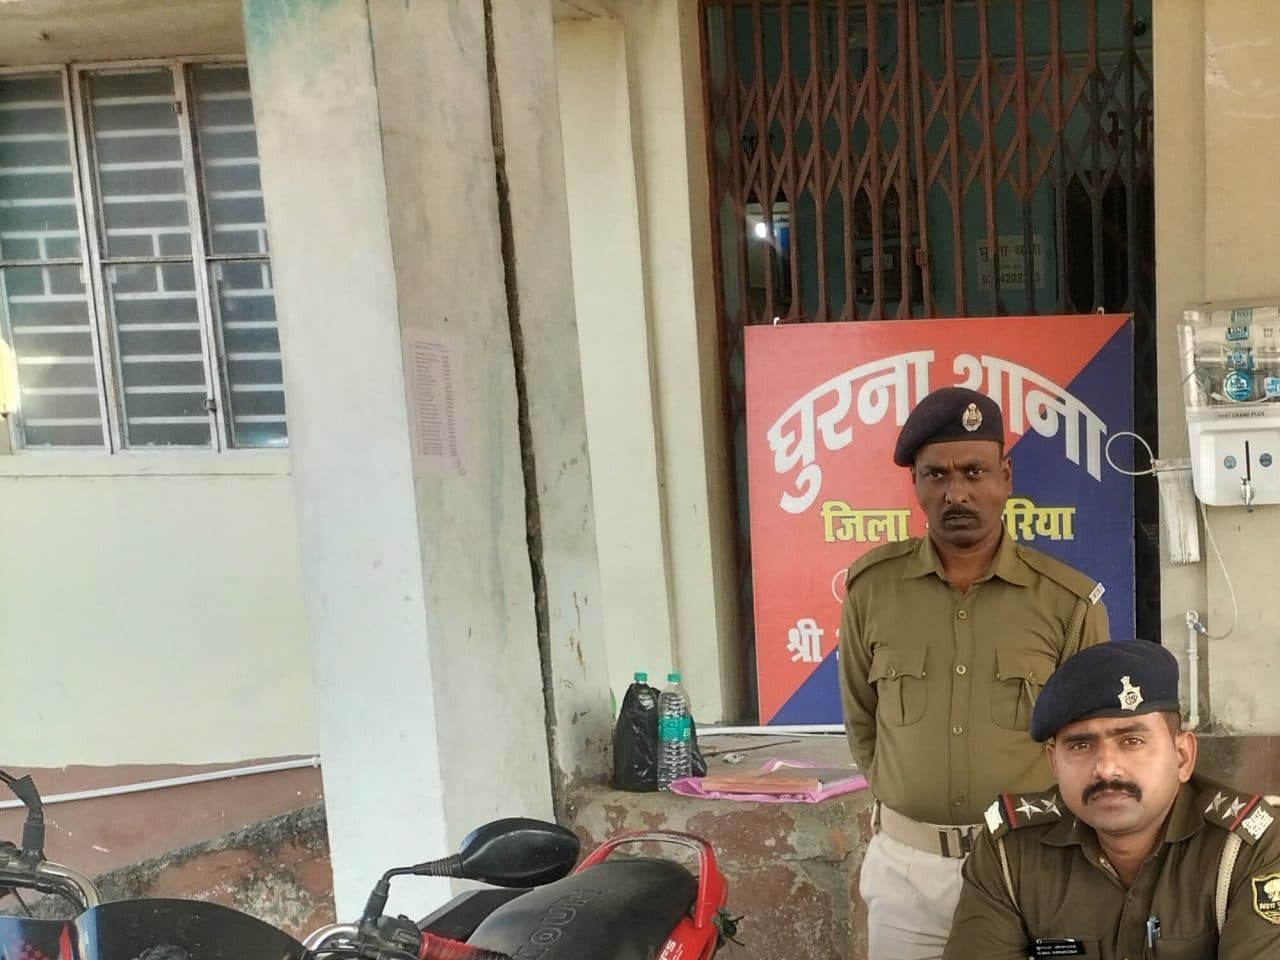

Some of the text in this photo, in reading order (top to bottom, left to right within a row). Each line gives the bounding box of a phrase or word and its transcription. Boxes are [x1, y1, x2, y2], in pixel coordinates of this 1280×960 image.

[767, 350, 935, 514] घुरना
[820, 500, 912, 543] जिला
[786, 617, 824, 662] श्री
